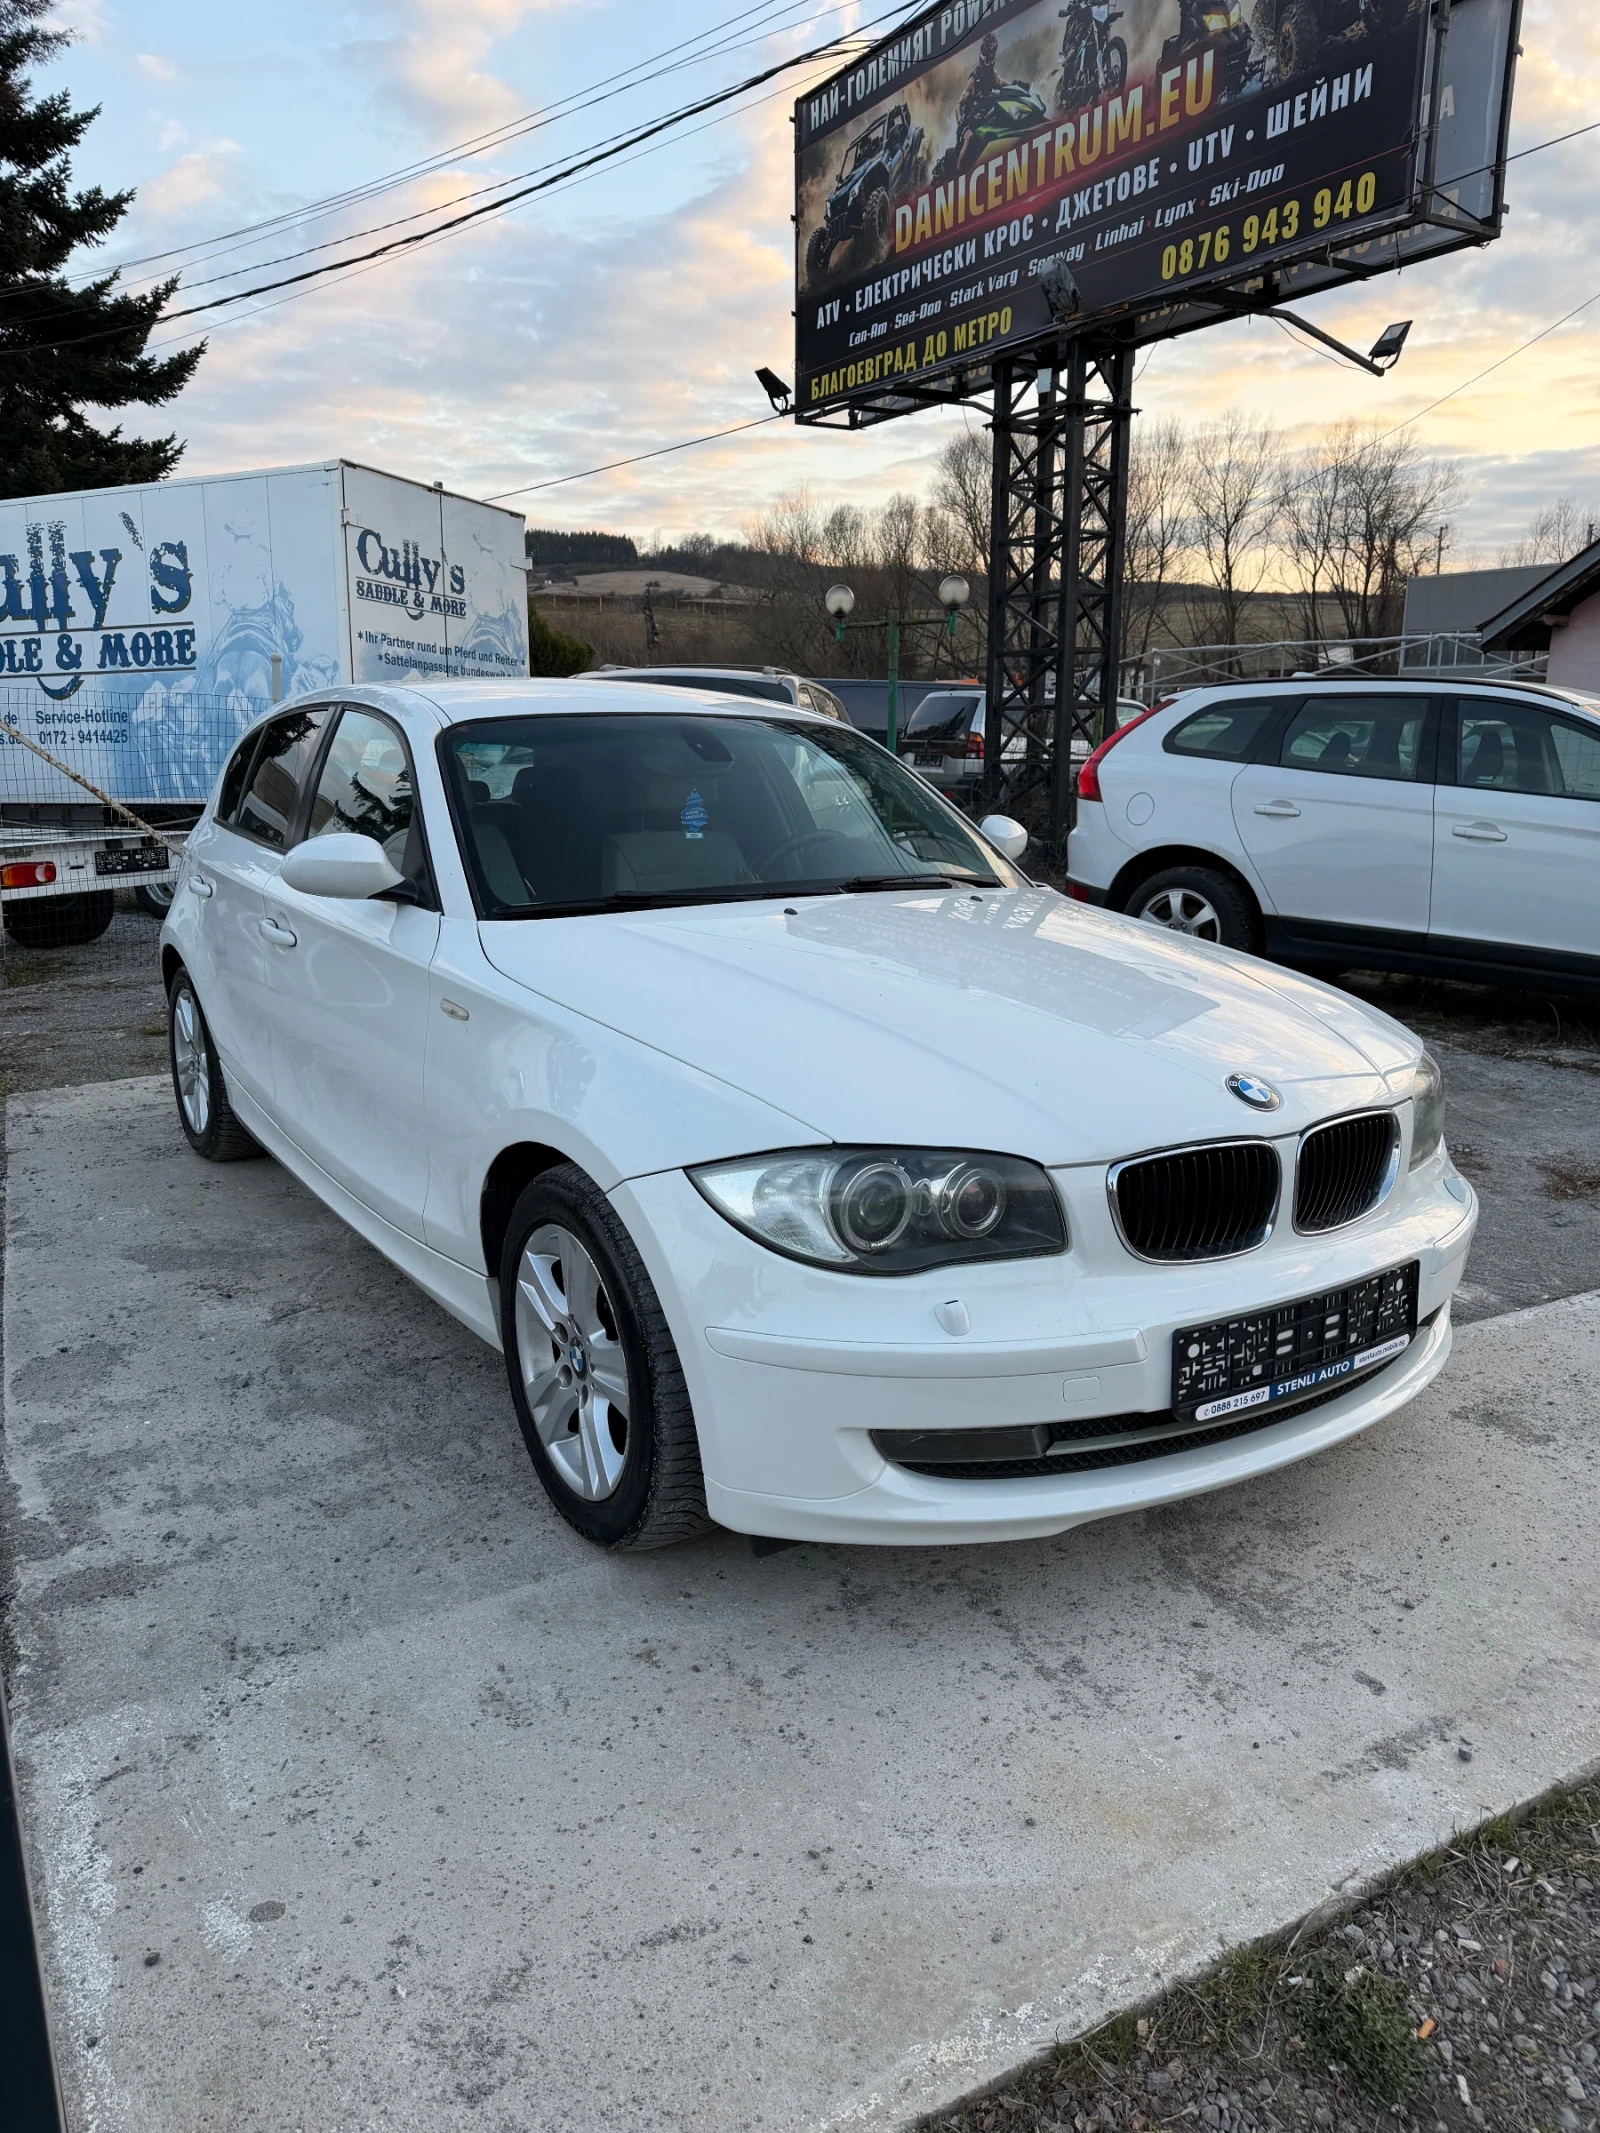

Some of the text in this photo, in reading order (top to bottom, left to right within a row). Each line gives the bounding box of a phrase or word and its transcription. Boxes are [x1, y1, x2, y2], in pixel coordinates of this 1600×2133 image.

[810, 21, 935, 131] НАЙ-ГОЛЕМИЯТ
[895, 49, 1214, 253] DANICENTRUM.EU
[816, 299, 840, 329] ATV
[855, 238, 976, 313] ЕЛЕКТРИЧЕСКИ
[984, 214, 1034, 258] КРОС
[1055, 157, 1160, 234] ДЖЕТОВЕ
[1187, 124, 1235, 171] UTV
[1266, 62, 1373, 140] ШЕЙНИ
[1161, 225, 1230, 280] 0876
[1242, 200, 1300, 253] 943
[1313, 172, 1376, 229] 940
[849, 320, 888, 347] Can-Am
[894, 299, 942, 329] Sea-Doo
[950, 281, 985, 308] Stark
[988, 268, 1019, 293] Varg
[1095, 215, 1145, 251] Linhai
[1154, 198, 1197, 229] Lynx
[1208, 163, 1285, 207] Ski-Doo
[811, 341, 916, 400] БЛАГОЕВГРАД
[922, 330, 947, 368] ДО
[954, 306, 1012, 352] МЕТРО
[356, 580, 466, 617] SADDLE & MORE
[55, 633, 82, 671] &
[97, 628, 197, 669] MORE
[380, 633, 415, 650] Partner
[417, 642, 437, 654] rund
[454, 645, 477, 661] Pferd
[478, 650, 497, 663] und
[495, 652, 518, 667] Reiter
[384, 652, 459, 675] Sattelanpassung
[36, 708, 128, 725] Service-Hotline
[39, 730, 67, 745] 0172
[78, 729, 128, 744] 9414425
[1210, 1400, 1231, 1414] 0888
[1233, 1396, 1249, 1408] 215
[1250, 1390, 1266, 1403] 697
[1276, 1373, 1316, 1395] STENLI
[1318, 1361, 1350, 1381] AUTO
